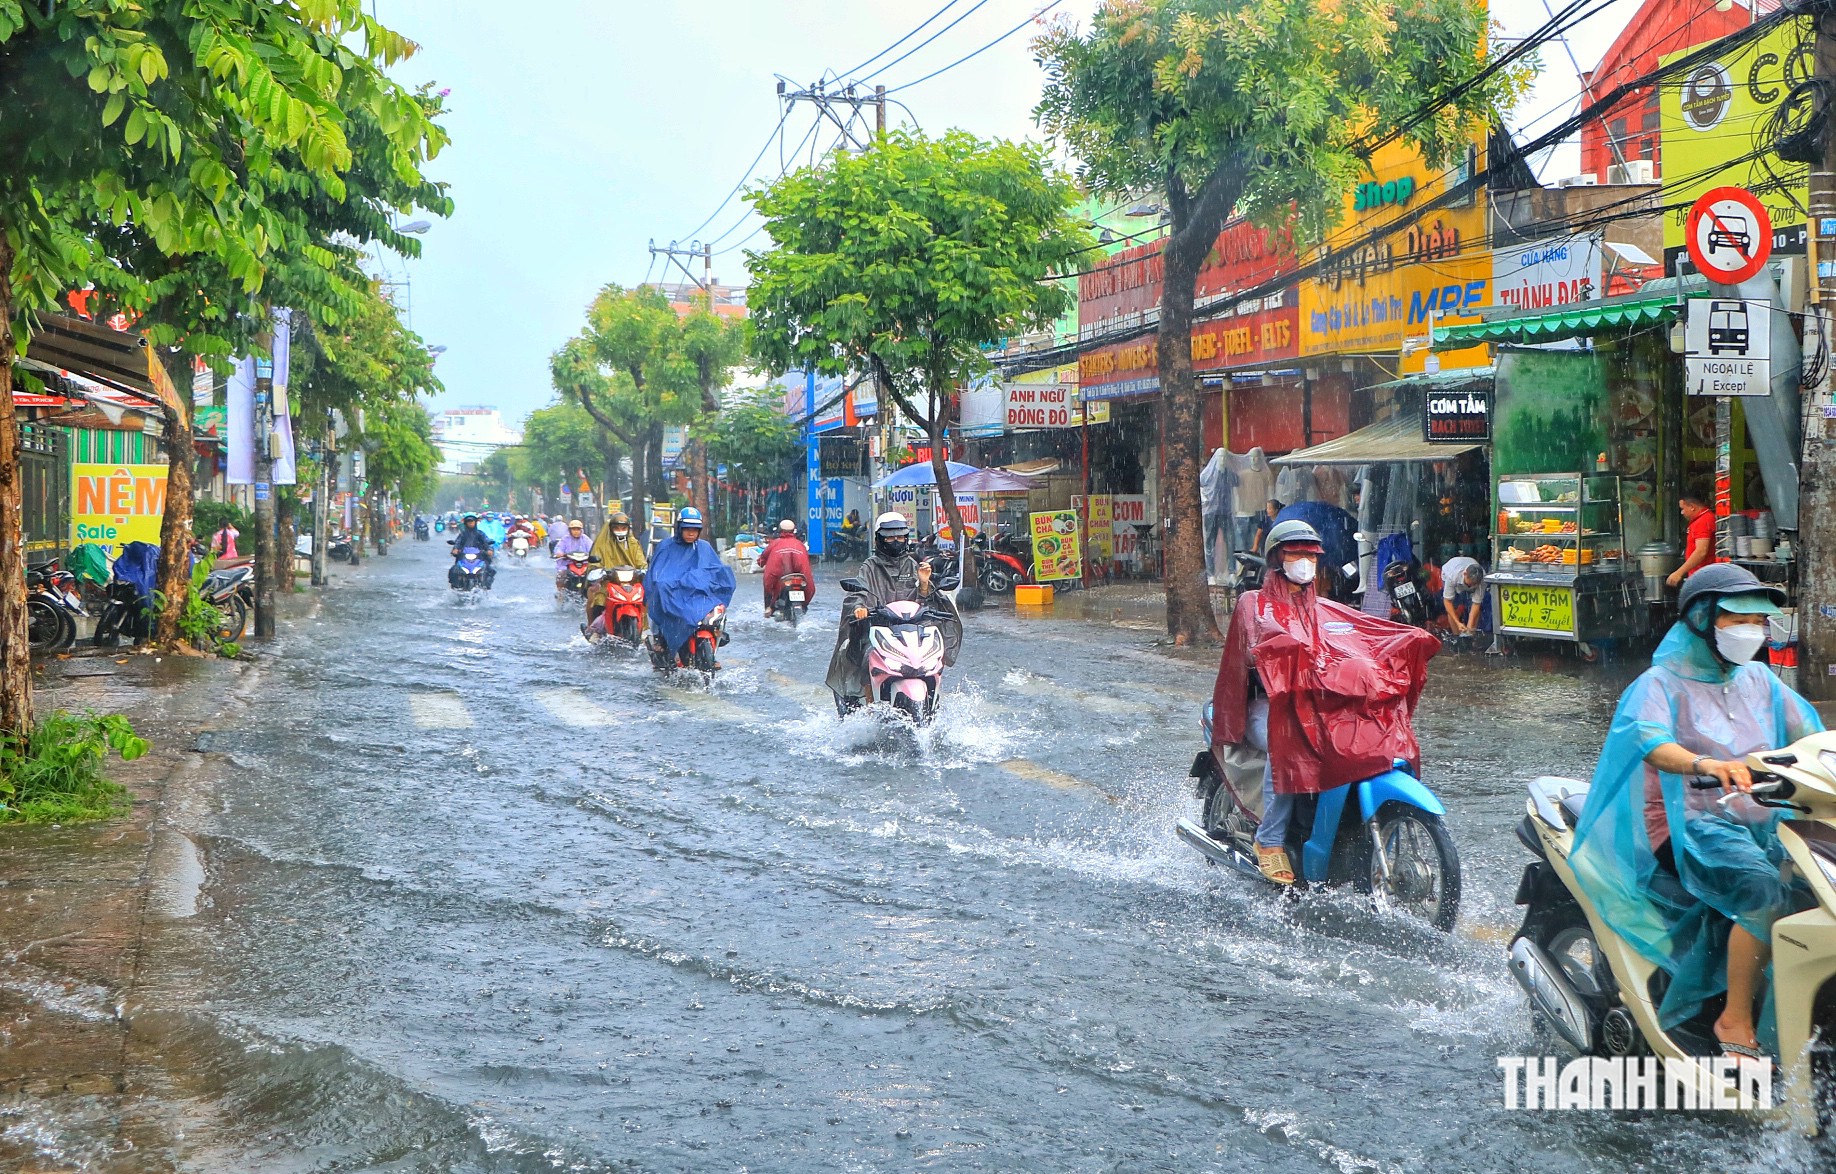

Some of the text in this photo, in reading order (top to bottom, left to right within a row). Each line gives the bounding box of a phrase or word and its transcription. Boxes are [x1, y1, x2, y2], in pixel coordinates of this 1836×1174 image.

[1353, 176, 1412, 211] Shop
[1703, 361, 1754, 378] NGOẠI LỆ
[1713, 380, 1746, 394] Except
[1009, 390, 1035, 403] ANH
[1039, 388, 1067, 403] NGỮ
[1007, 404, 1068, 425] ĐÔNG ĐÔ
[78, 469, 167, 524] NỆM
[77, 523, 117, 539] Sale
[1511, 591, 1539, 605] CƠM
